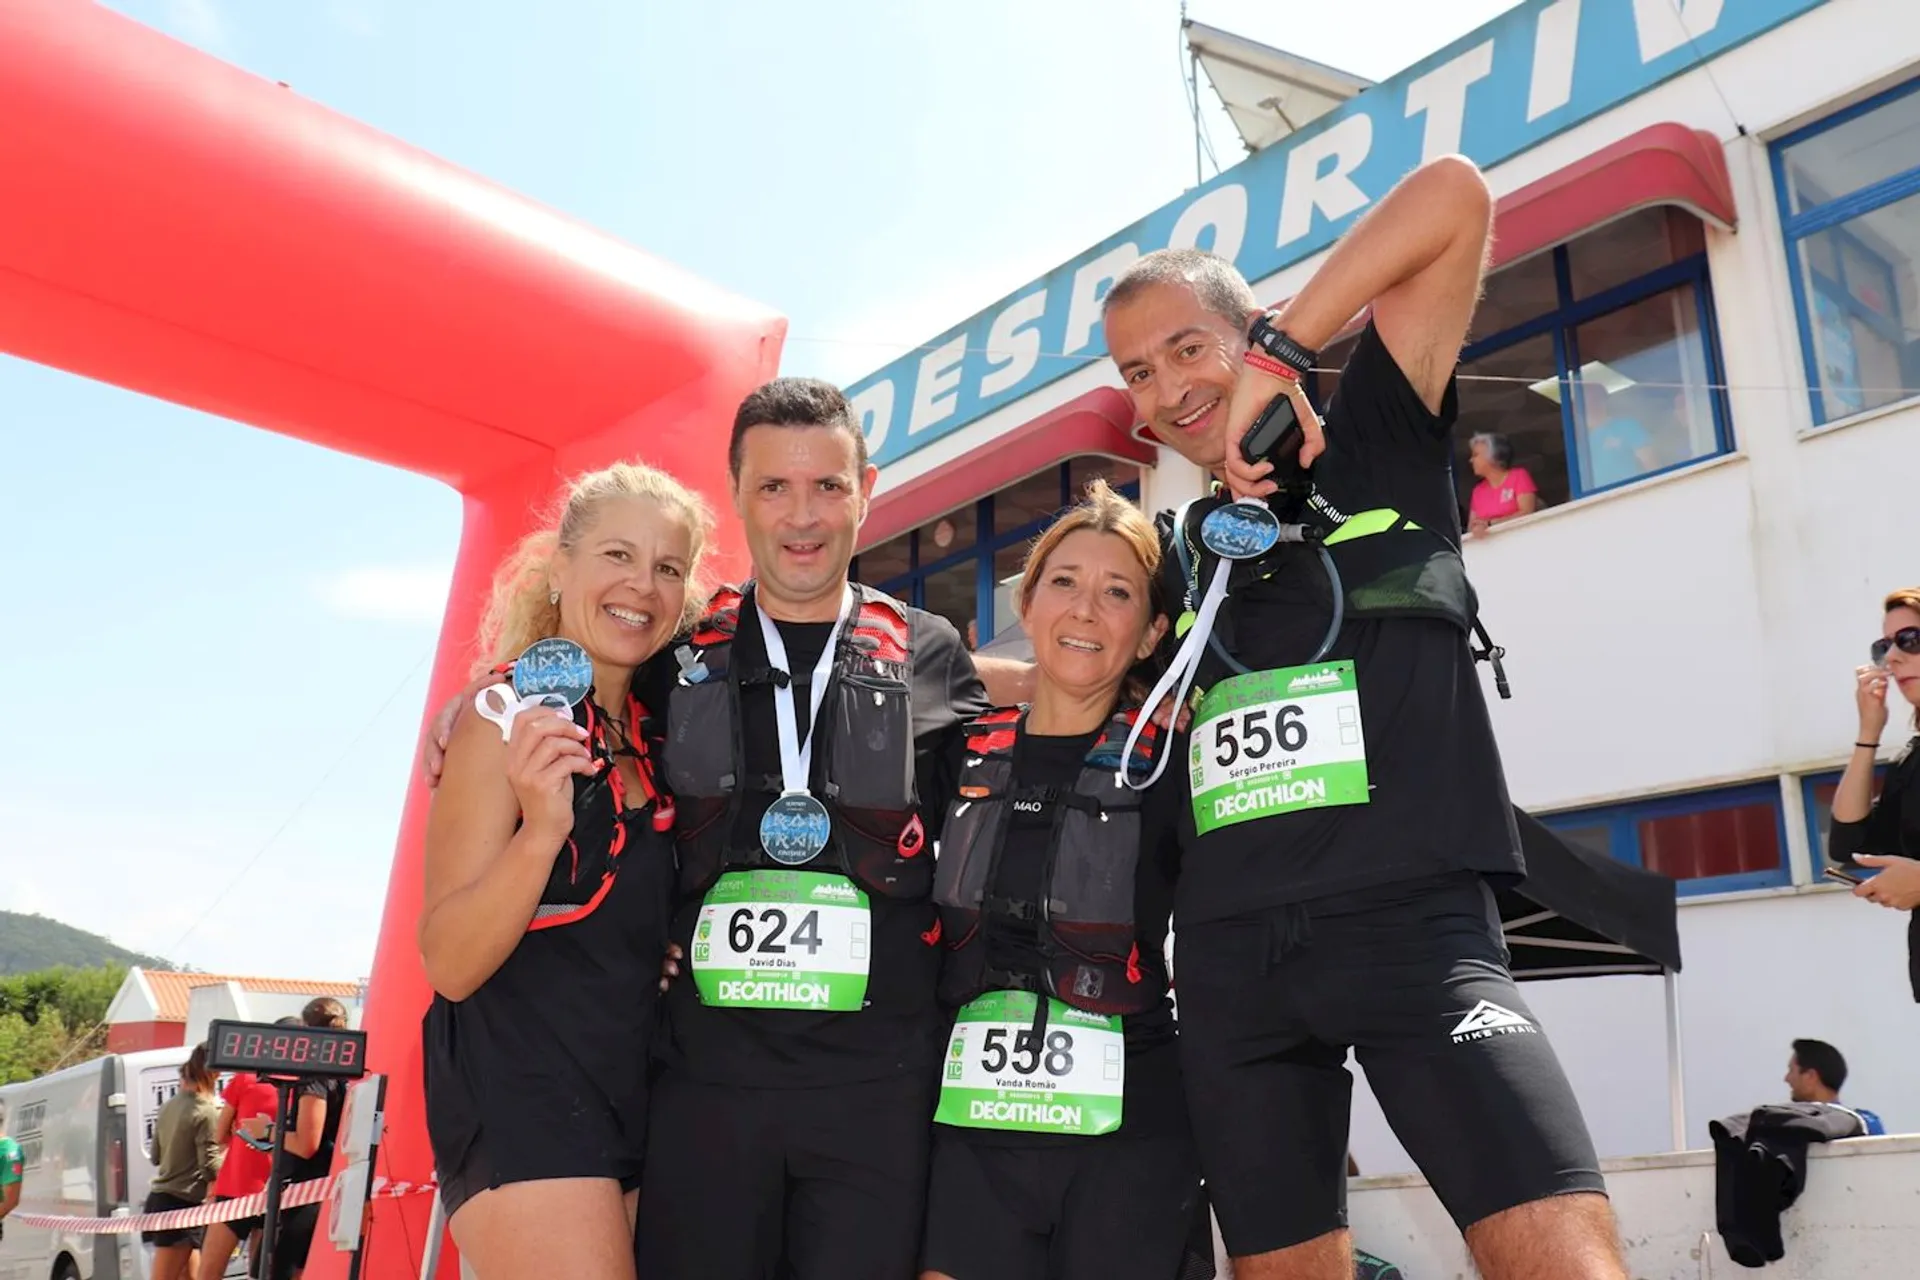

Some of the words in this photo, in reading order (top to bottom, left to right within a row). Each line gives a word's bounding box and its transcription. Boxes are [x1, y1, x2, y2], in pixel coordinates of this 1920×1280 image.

[1215, 704, 1308, 767] 556
[1229, 767, 1258, 779] Sérgio
[1260, 759, 1296, 771] Pereira
[1214, 777, 1326, 820] DECATHLON
[728, 908, 822, 955] 624
[749, 958, 775, 967] David
[777, 958, 796, 968] Dias
[719, 981, 830, 1003] DECATHLON
[1452, 1029, 1493, 1044] NIKE
[1497, 1025, 1538, 1035] TRAIL
[228, 1032, 357, 1066] 11:40:13
[981, 1028, 1074, 1076] 558
[996, 1078, 1022, 1088] Vanda
[1025, 1079, 1056, 1090] Romão
[970, 1100, 1082, 1125] DECATHLON
